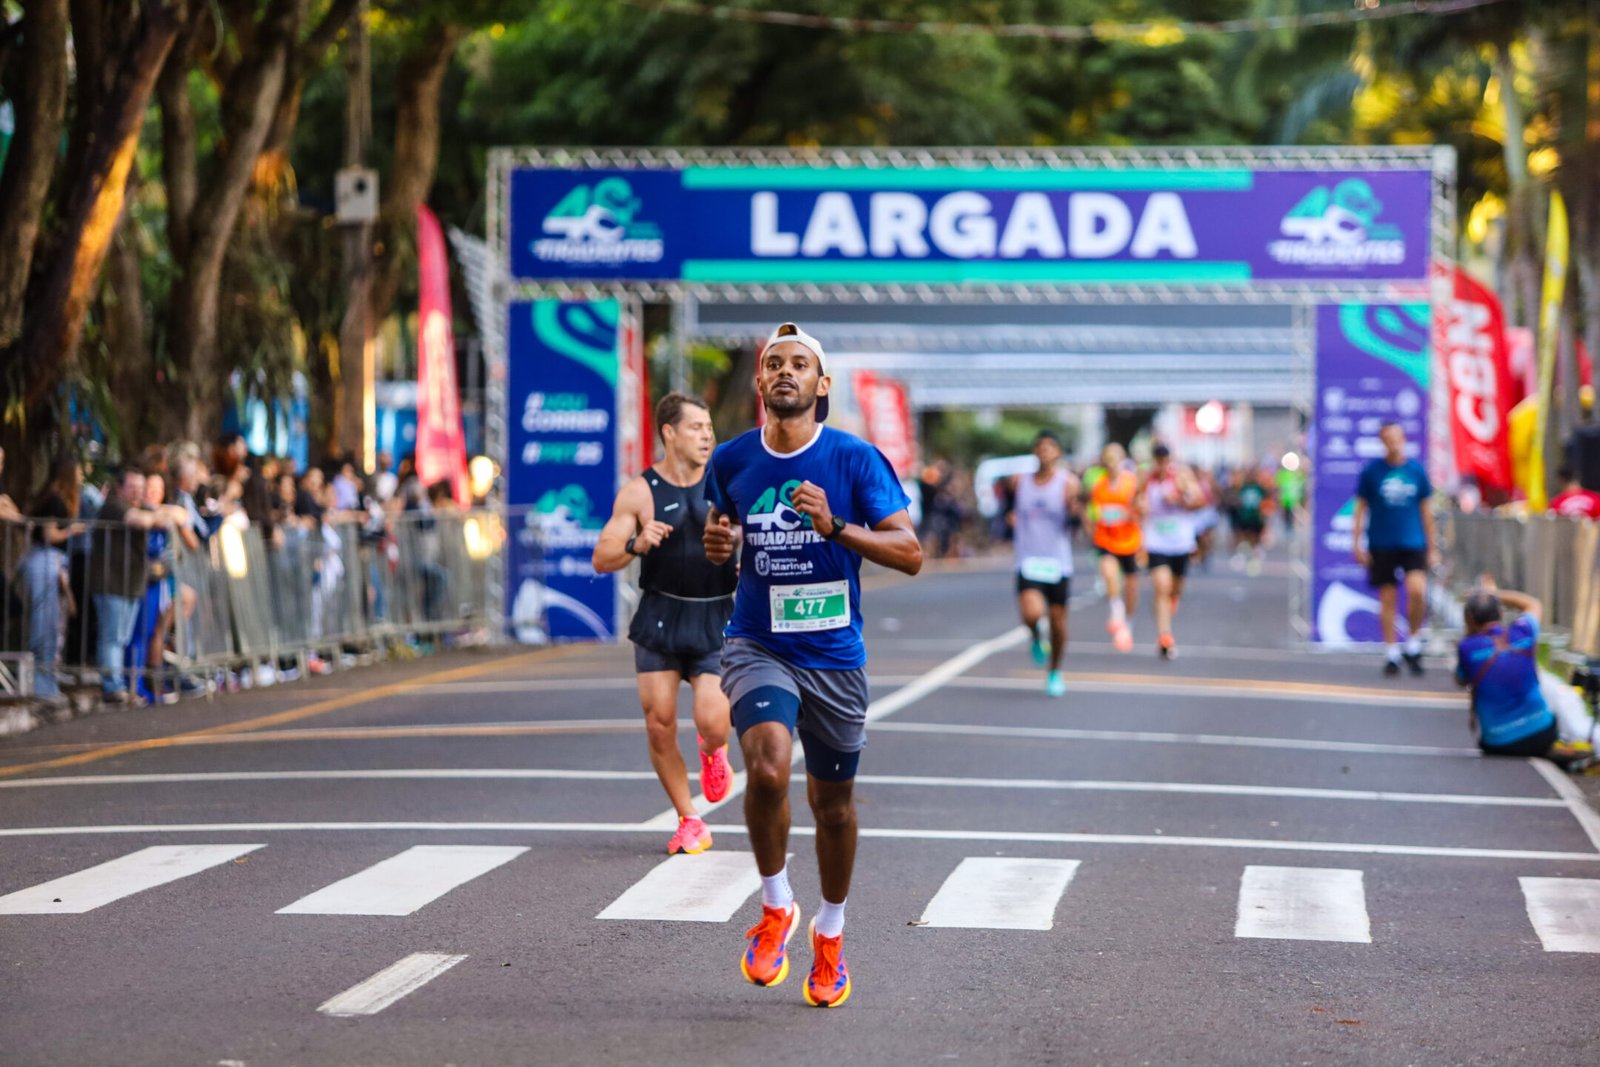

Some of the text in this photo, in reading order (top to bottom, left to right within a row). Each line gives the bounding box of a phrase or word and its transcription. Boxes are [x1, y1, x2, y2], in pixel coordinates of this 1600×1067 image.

[750, 191, 1198, 258] LARGADA
[771, 560, 813, 571] Maringá
[794, 598, 827, 616] 477
